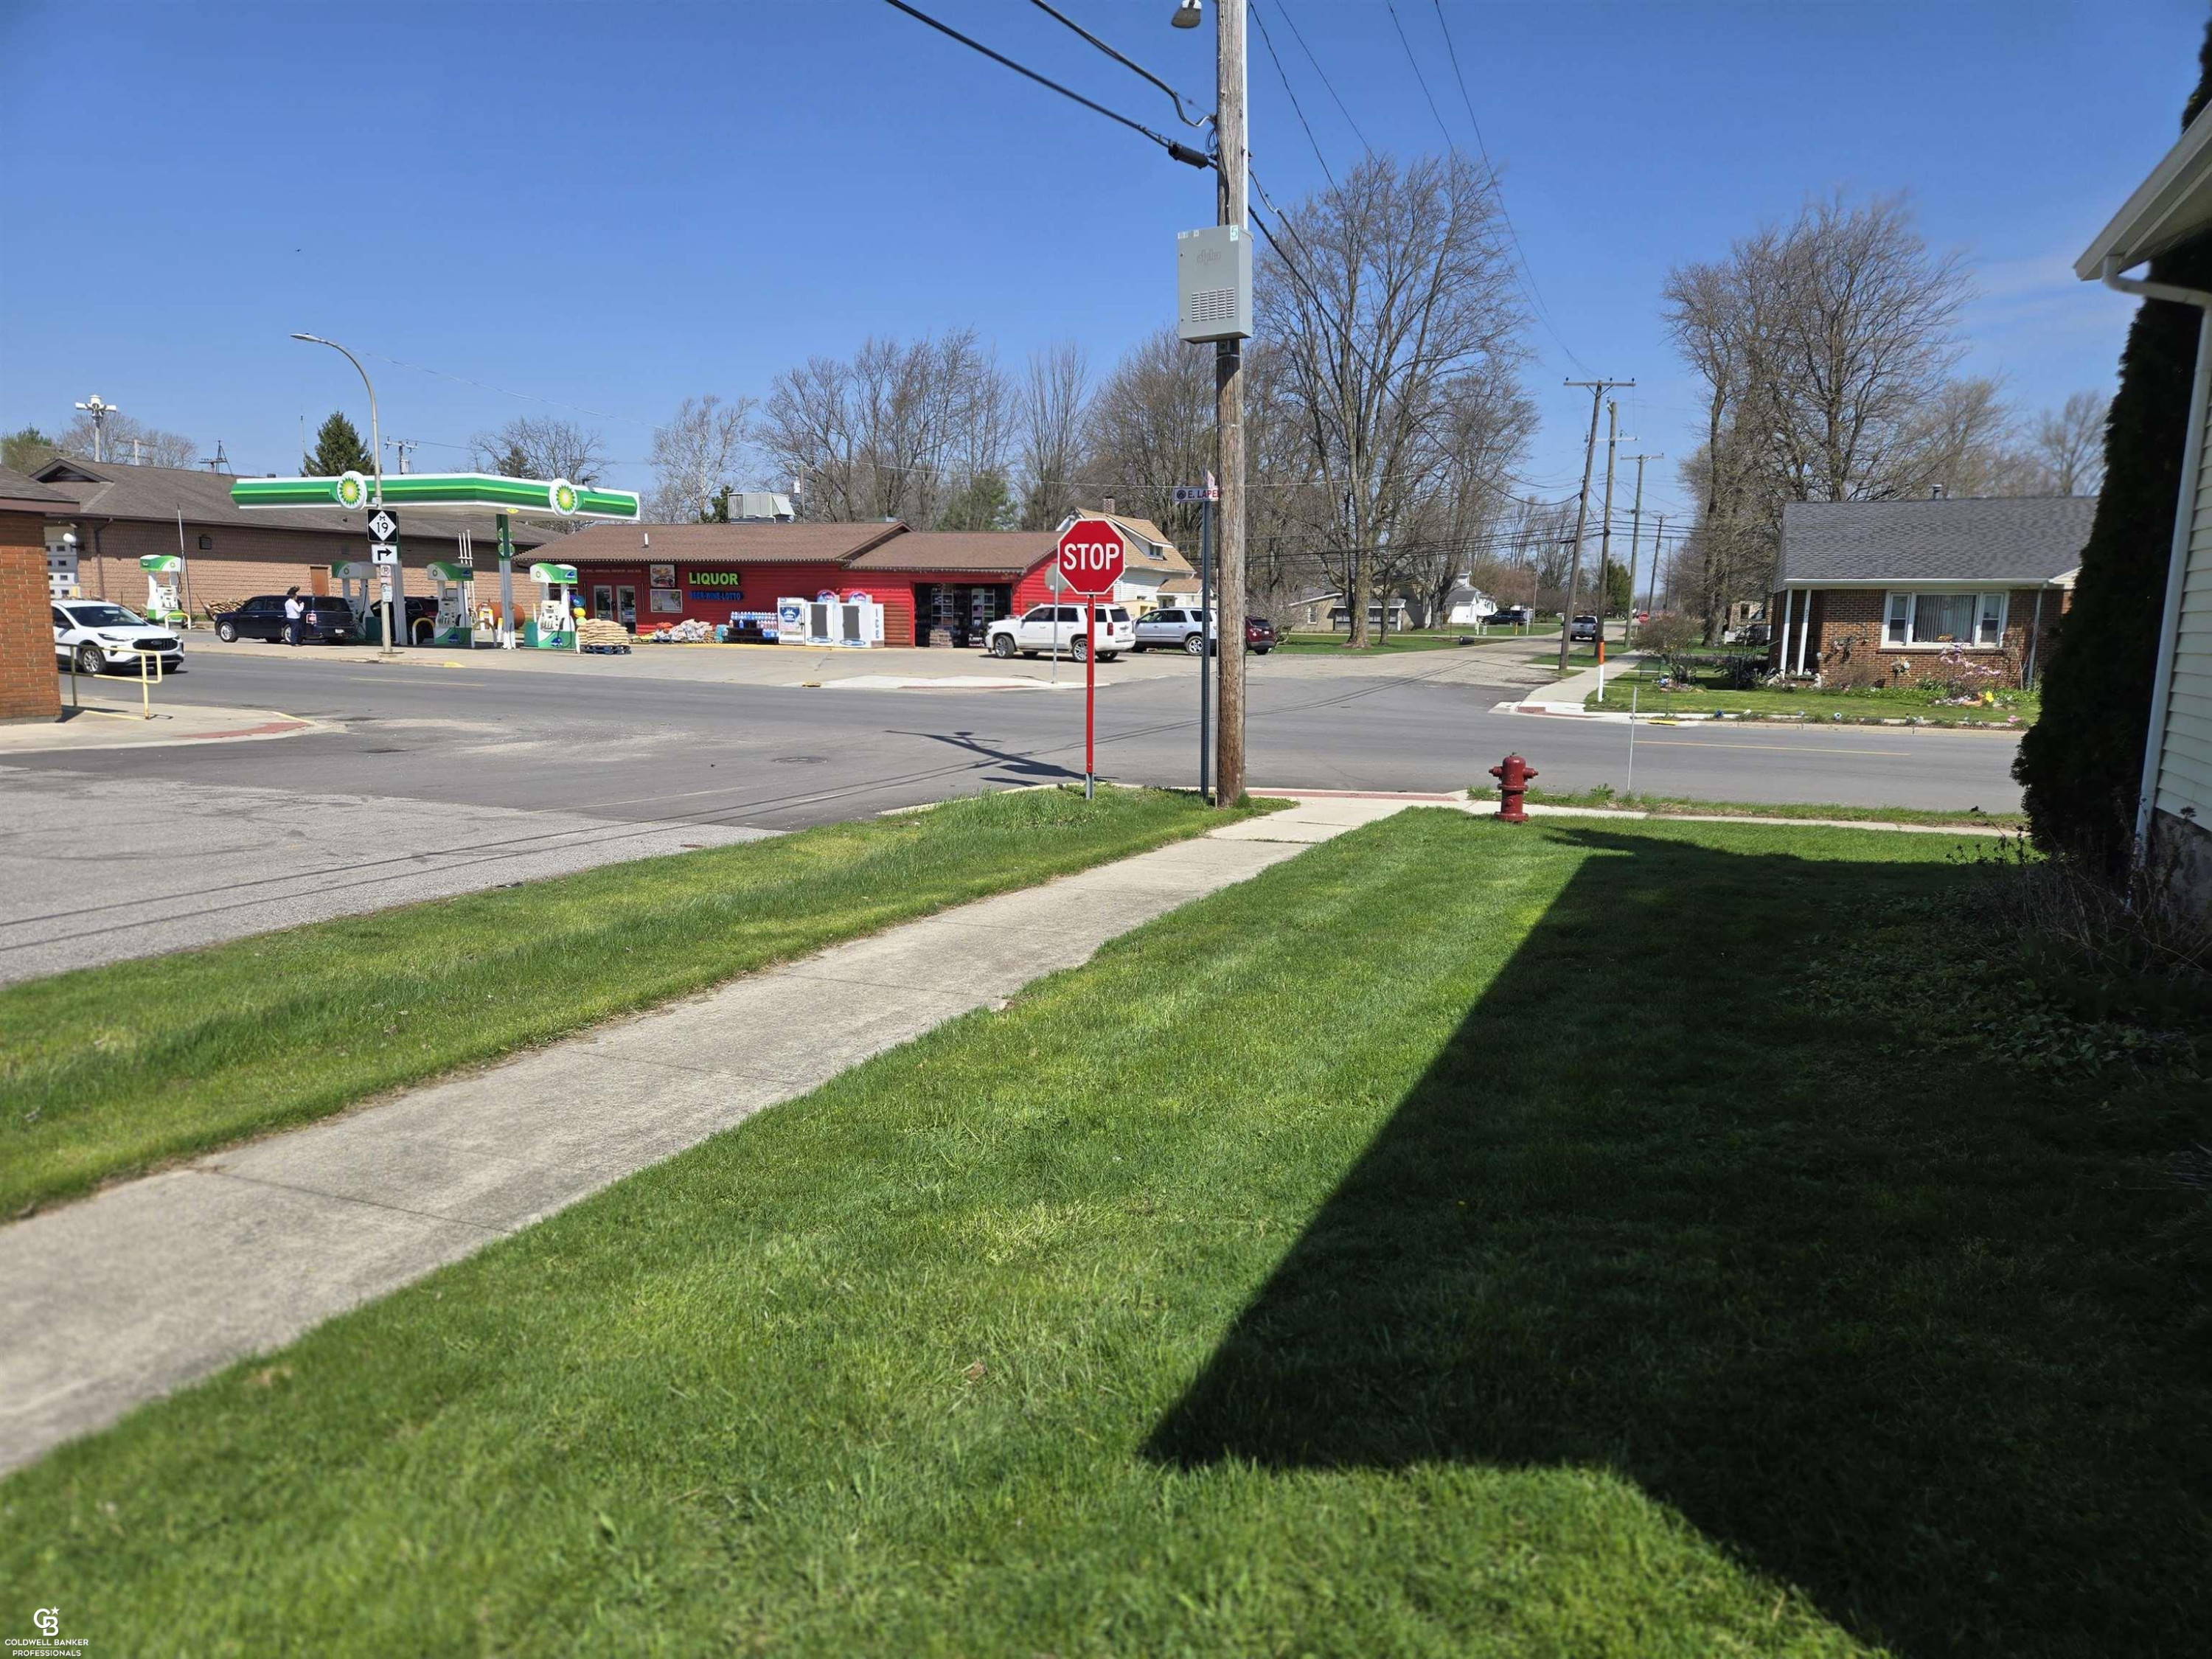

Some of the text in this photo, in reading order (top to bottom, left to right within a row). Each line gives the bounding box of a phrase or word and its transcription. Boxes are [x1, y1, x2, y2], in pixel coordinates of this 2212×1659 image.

[1188, 490, 1195, 498] E.
[377, 522, 389, 533] 19
[1063, 543, 1120, 571] STOP
[689, 572, 739, 585] LIQUOR
